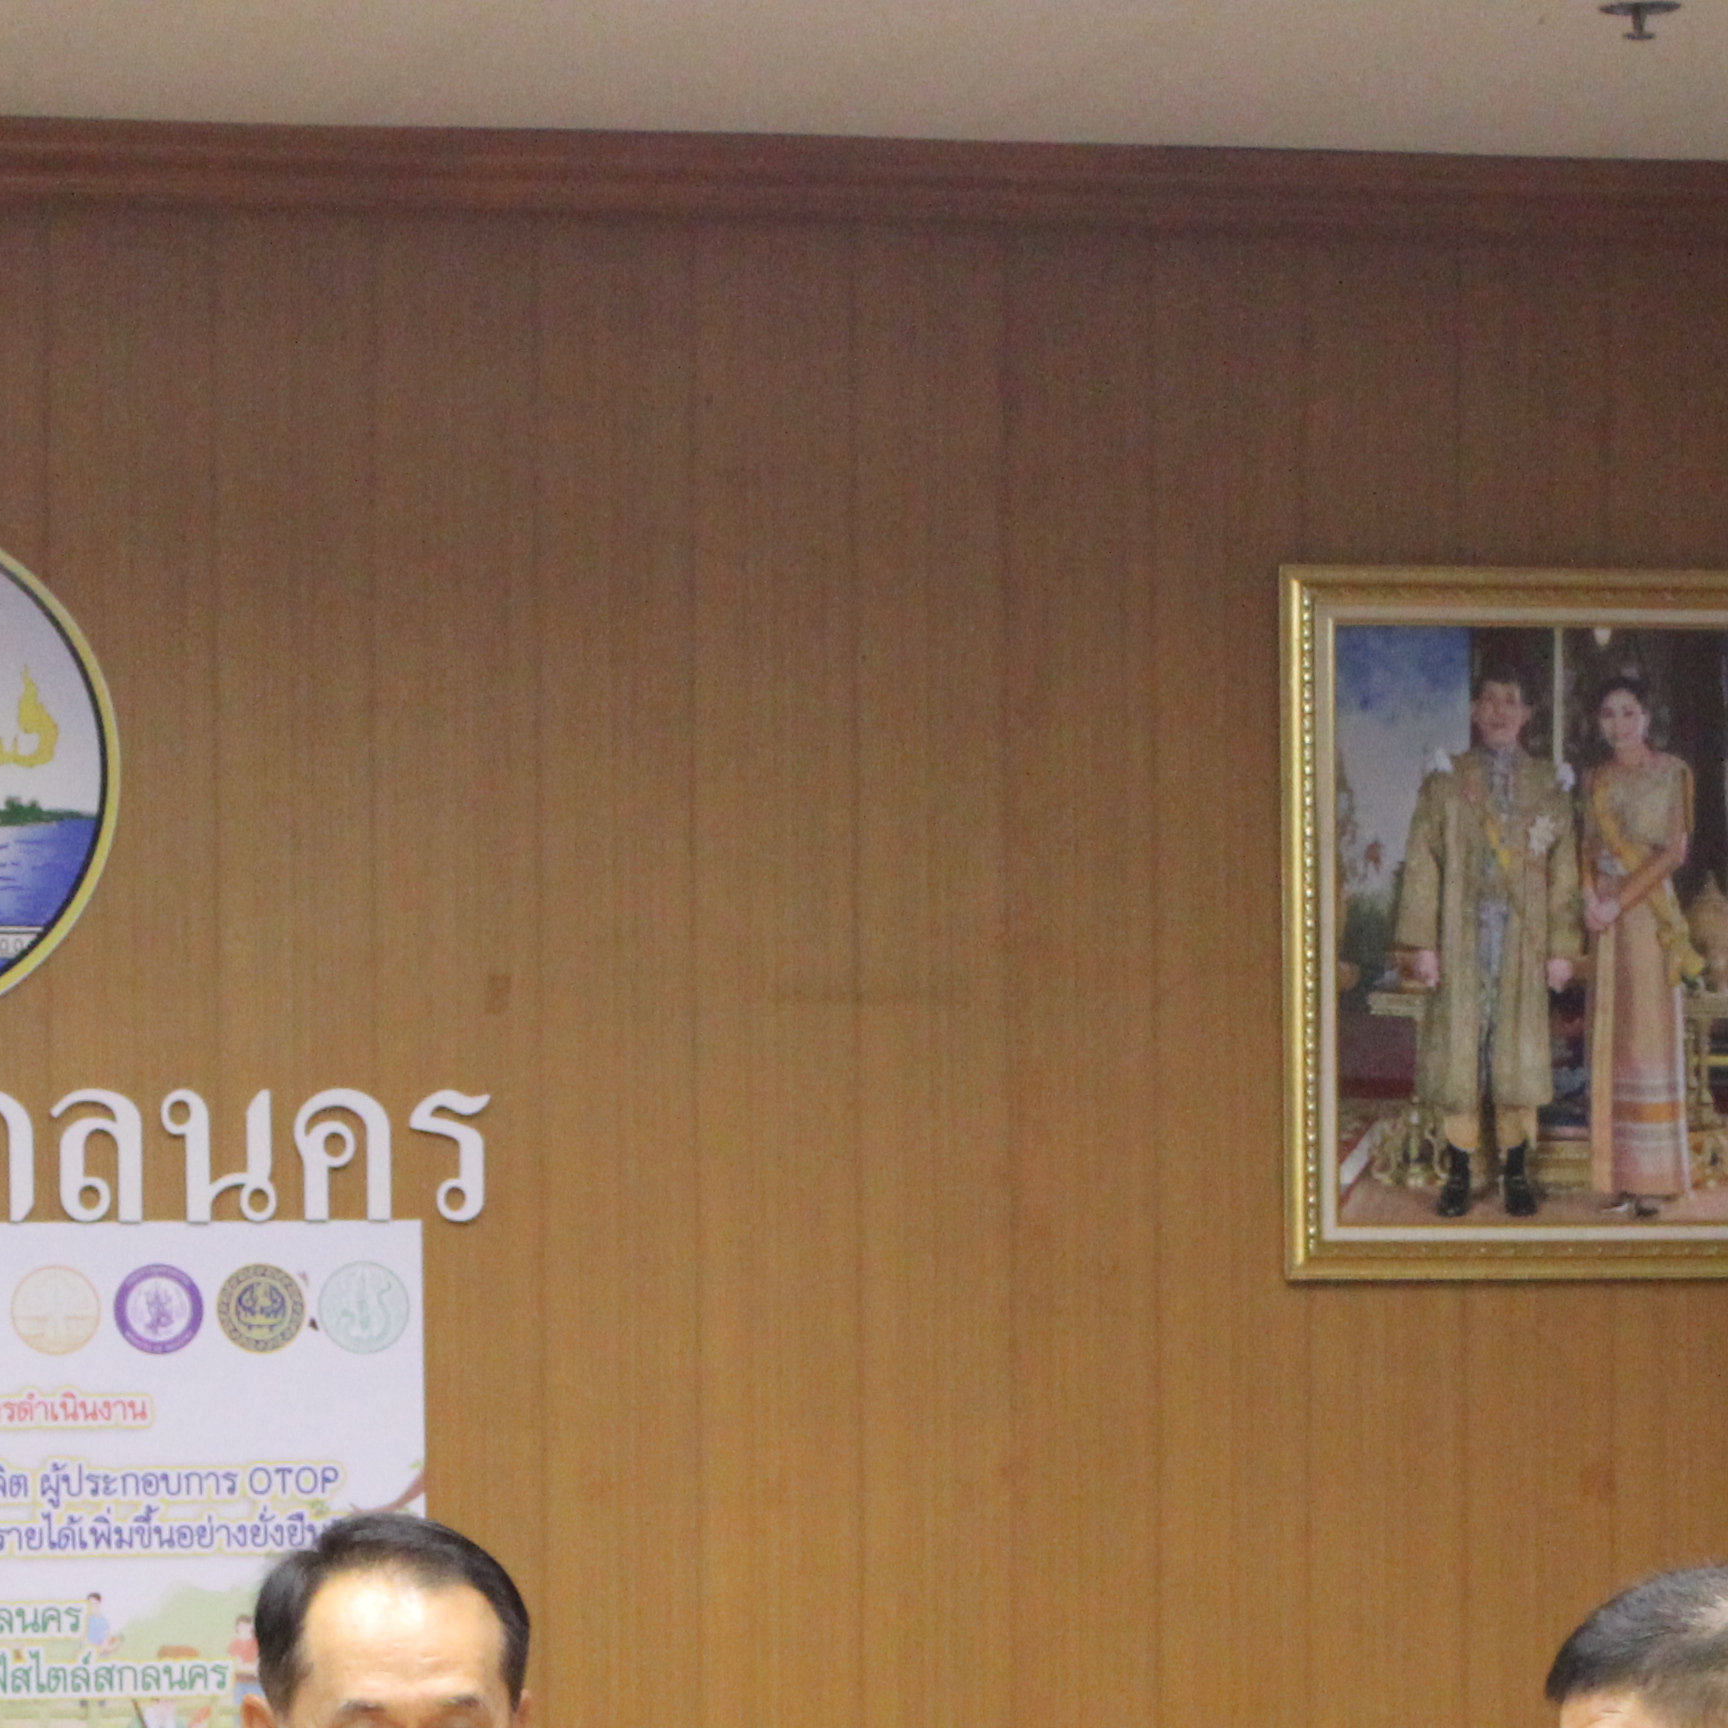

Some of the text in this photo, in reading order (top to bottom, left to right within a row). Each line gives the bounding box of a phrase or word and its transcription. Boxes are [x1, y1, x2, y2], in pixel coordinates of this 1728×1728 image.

[40, 1460, 239, 1508] ผู้ประกอบการ
[249, 1466, 341, 1497] OTOP
